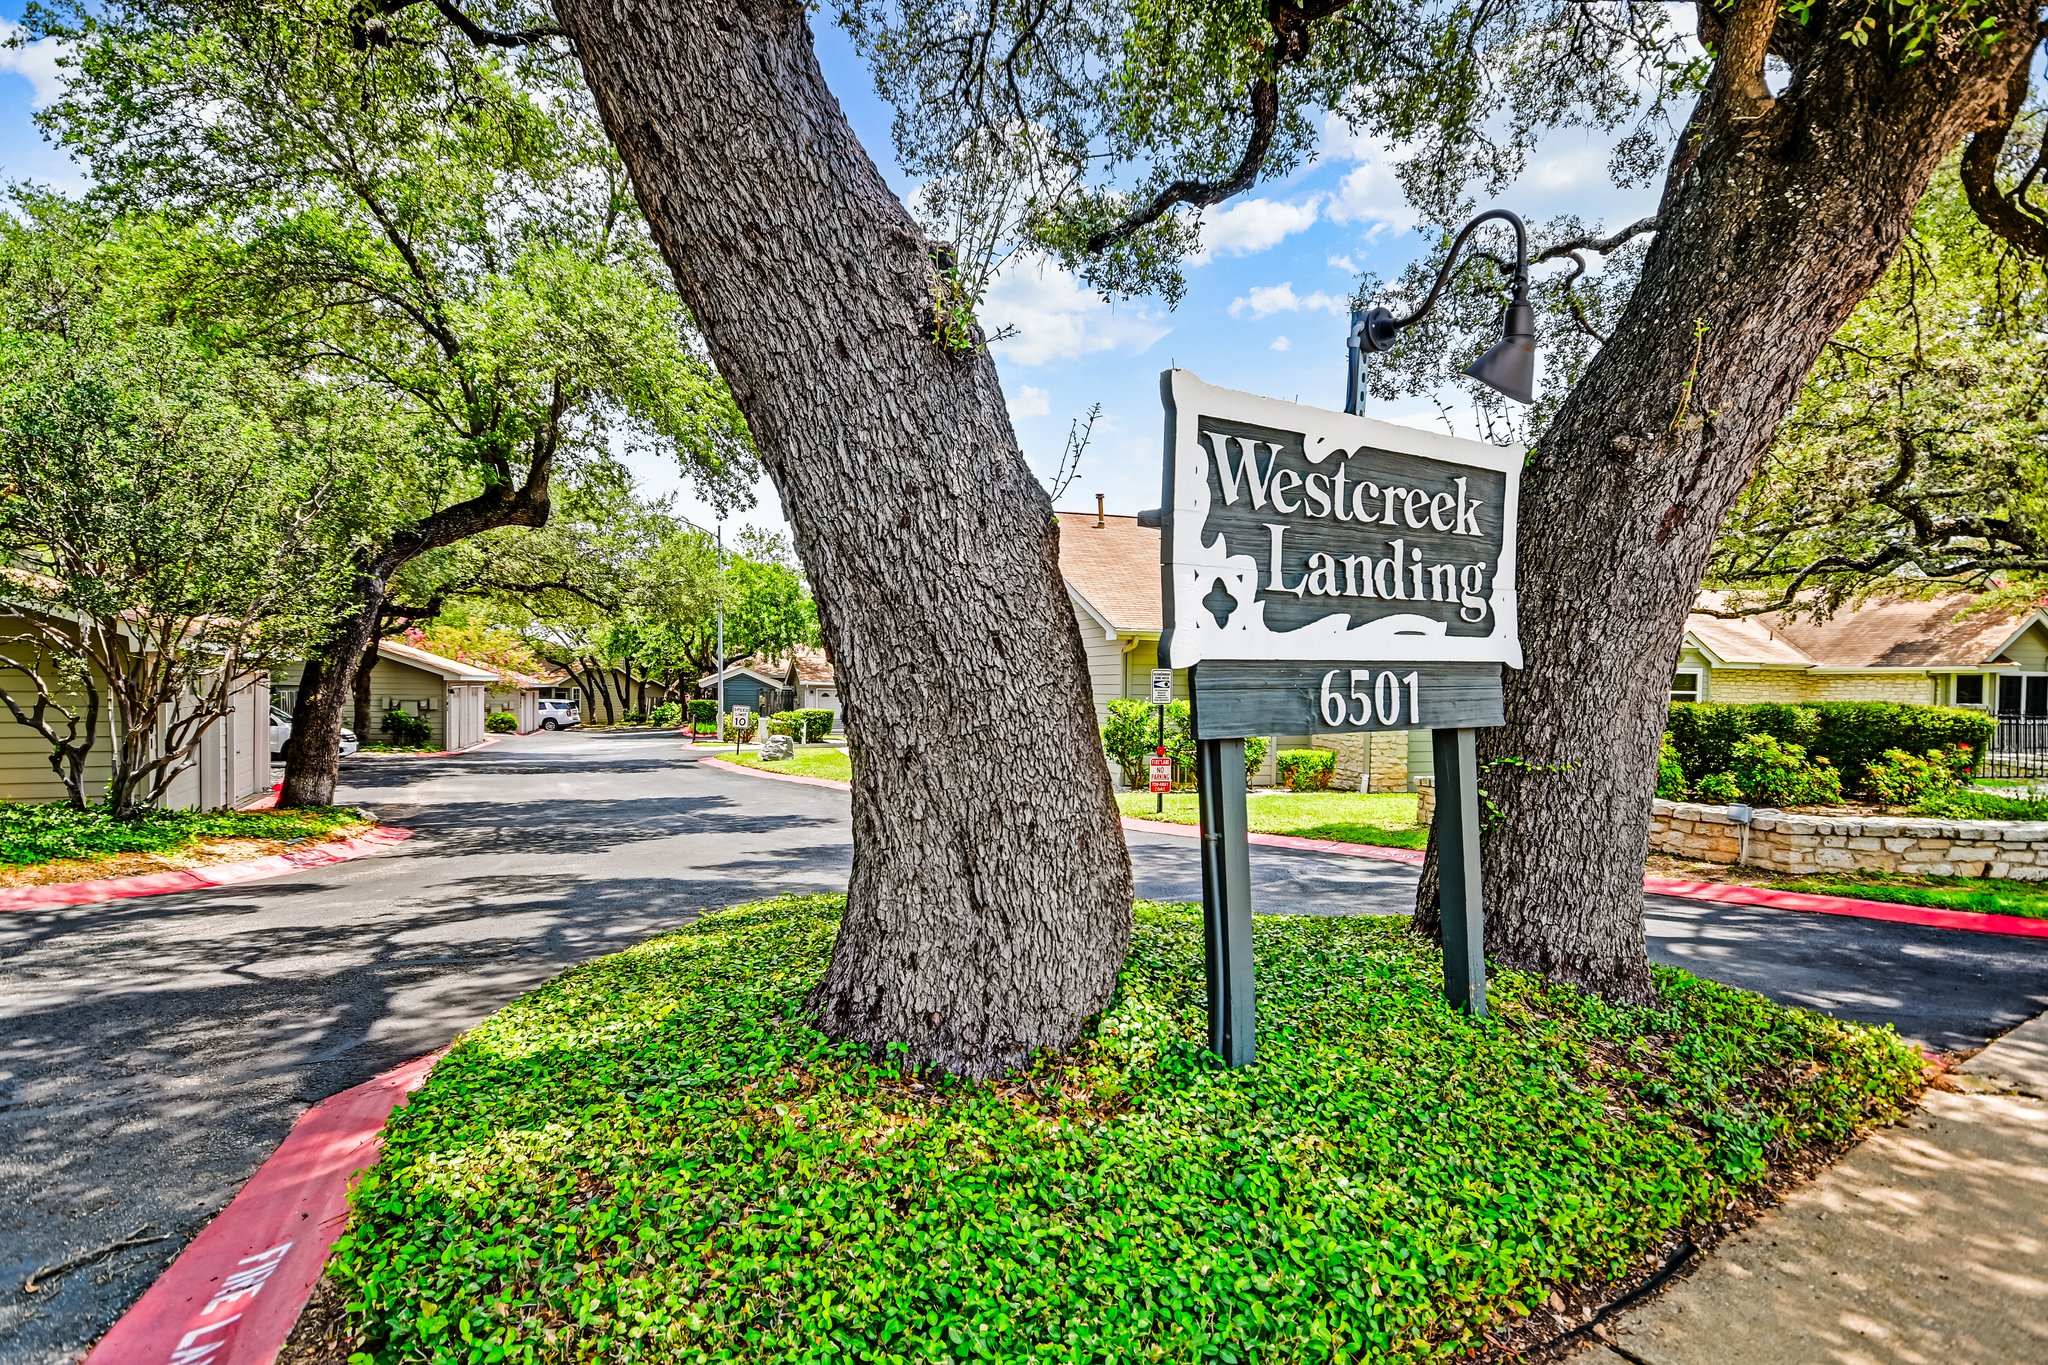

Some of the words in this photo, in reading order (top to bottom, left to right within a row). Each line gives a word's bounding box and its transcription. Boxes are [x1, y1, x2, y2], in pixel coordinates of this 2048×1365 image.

[1203, 431, 1485, 537] Westcreek
[1262, 523, 1487, 623] Landing
[735, 717, 746, 726] 10
[1320, 669, 1419, 727] 6501
[1151, 773, 1170, 781] PARKING
